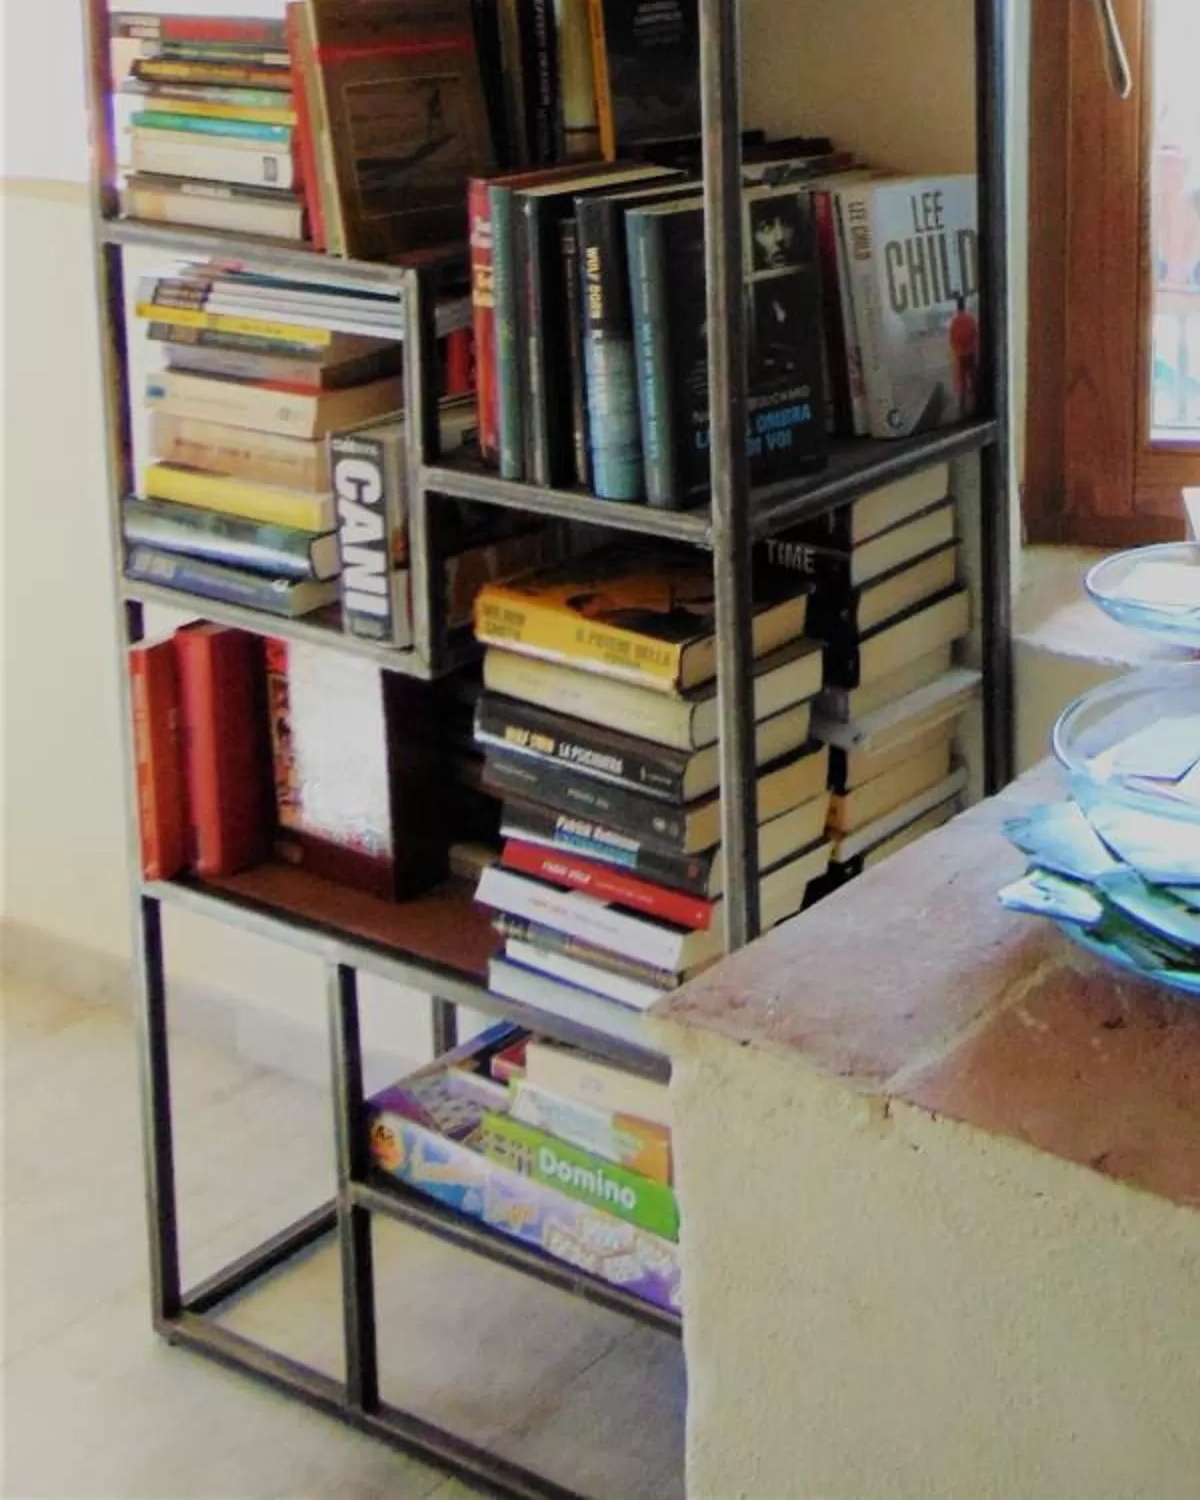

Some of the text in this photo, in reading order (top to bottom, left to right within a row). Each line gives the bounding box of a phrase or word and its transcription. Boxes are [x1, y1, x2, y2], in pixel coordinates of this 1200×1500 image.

[911, 188, 945, 234] LEE
[885, 227, 980, 315] CHILD
[334, 457, 390, 618] CANI
[764, 537, 816, 575] TIME
[537, 1146, 637, 1212] Domino
